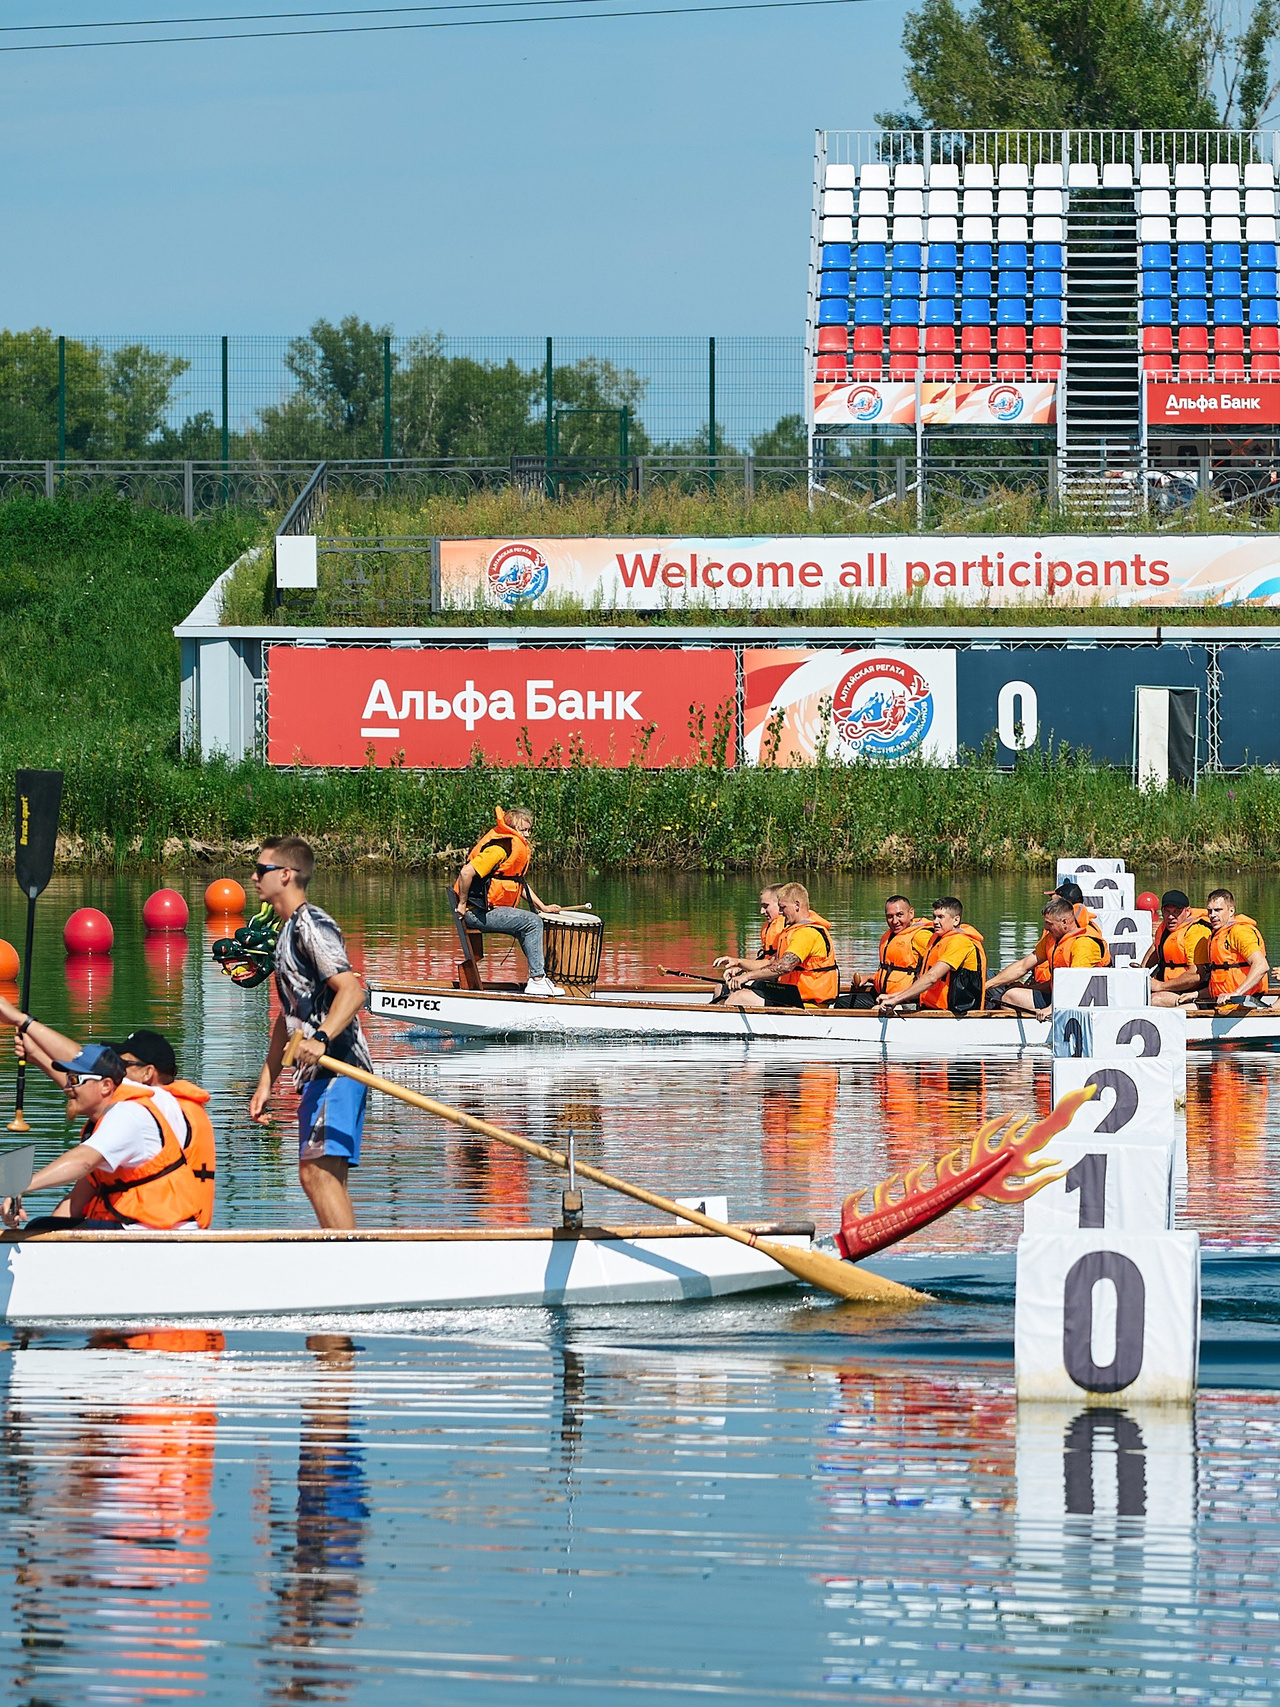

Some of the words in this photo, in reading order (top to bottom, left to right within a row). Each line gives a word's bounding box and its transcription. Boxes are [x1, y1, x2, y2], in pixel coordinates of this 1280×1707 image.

[1166, 394, 1218, 413] Альфа
[1221, 394, 1260, 409] Банк
[615, 553, 823, 588] Welcome
[839, 552, 888, 587] all
[906, 551, 1170, 595] participants
[361, 679, 515, 731] Альфа
[526, 679, 643, 720] Банк
[840, 665, 874, 702] АЛТАЙСКАЯ
[876, 664, 905, 676] РЕГАТА
[997, 680, 1038, 751] 0
[382, 997, 441, 1011] PLASTEX
[1084, 1068, 1138, 1133] 2
[1065, 1153, 1107, 1229] 1
[1063, 1250, 1145, 1393] 0
